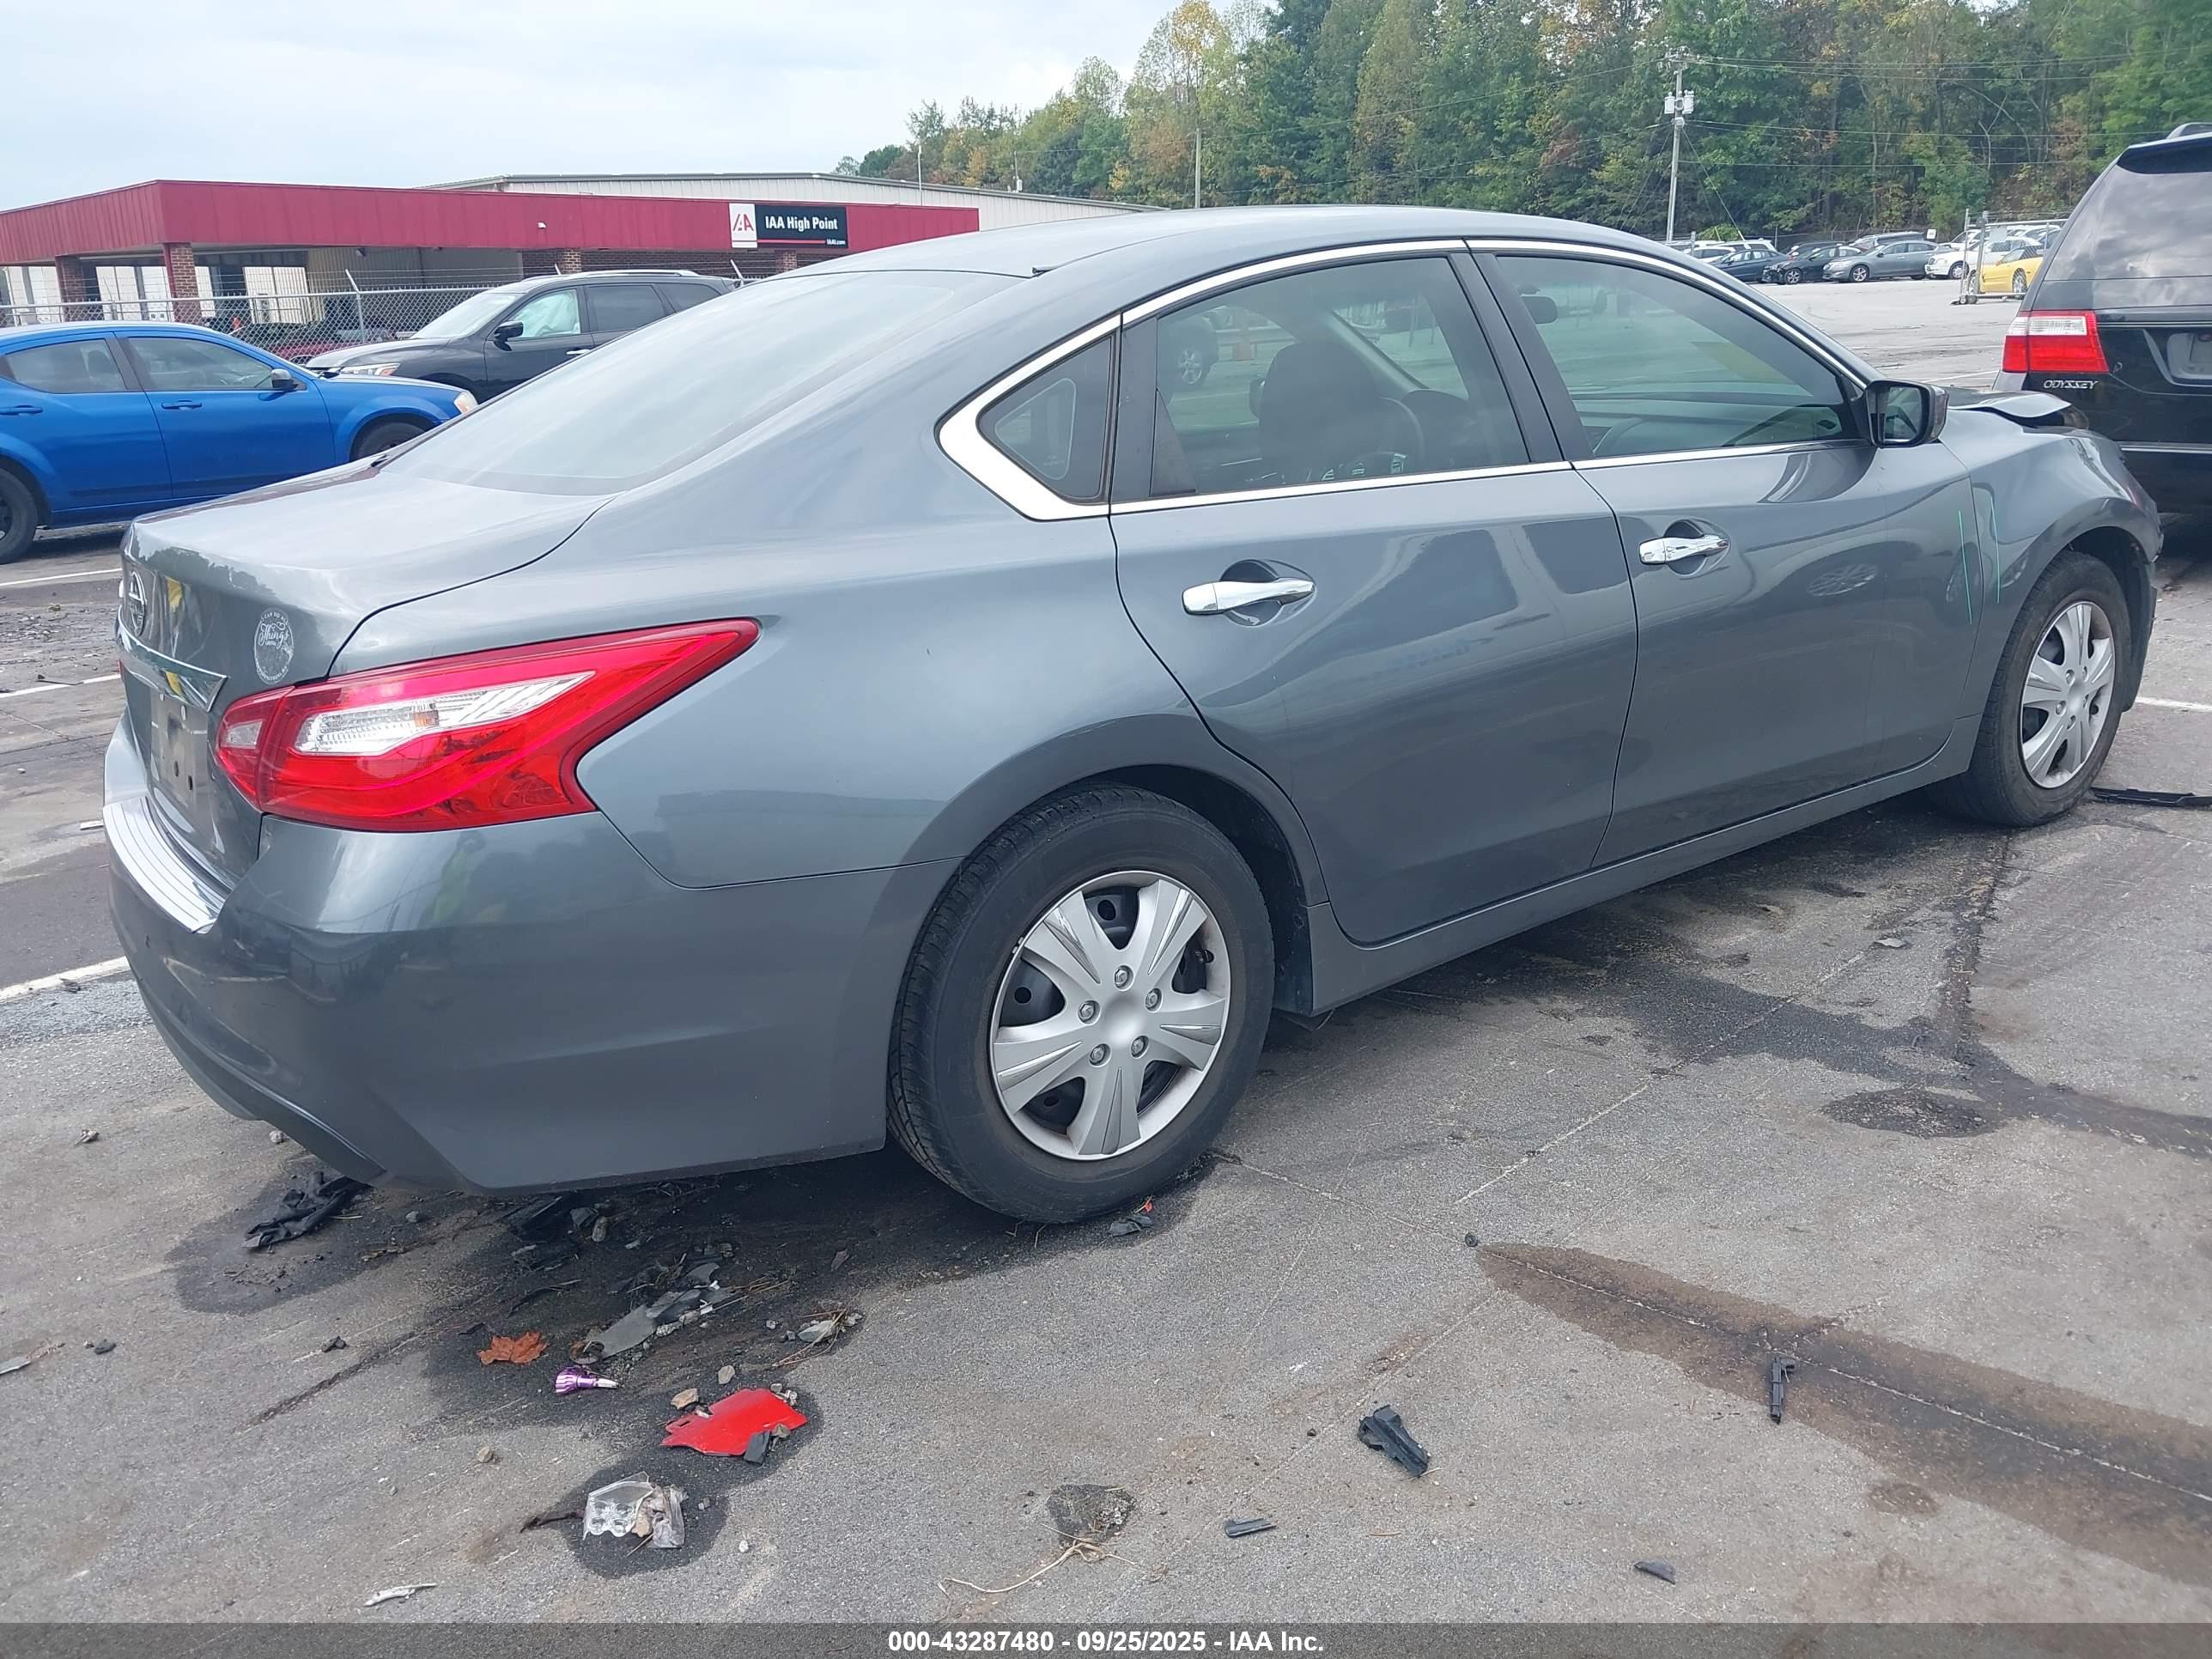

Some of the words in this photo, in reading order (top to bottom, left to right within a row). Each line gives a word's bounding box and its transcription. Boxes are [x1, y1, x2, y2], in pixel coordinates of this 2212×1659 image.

[765, 216, 785, 229] IAA
[787, 216, 811, 232] High
[812, 216, 838, 230] Point
[2043, 380, 2100, 389] ODYSSEY
[258, 621, 289, 649] Things
